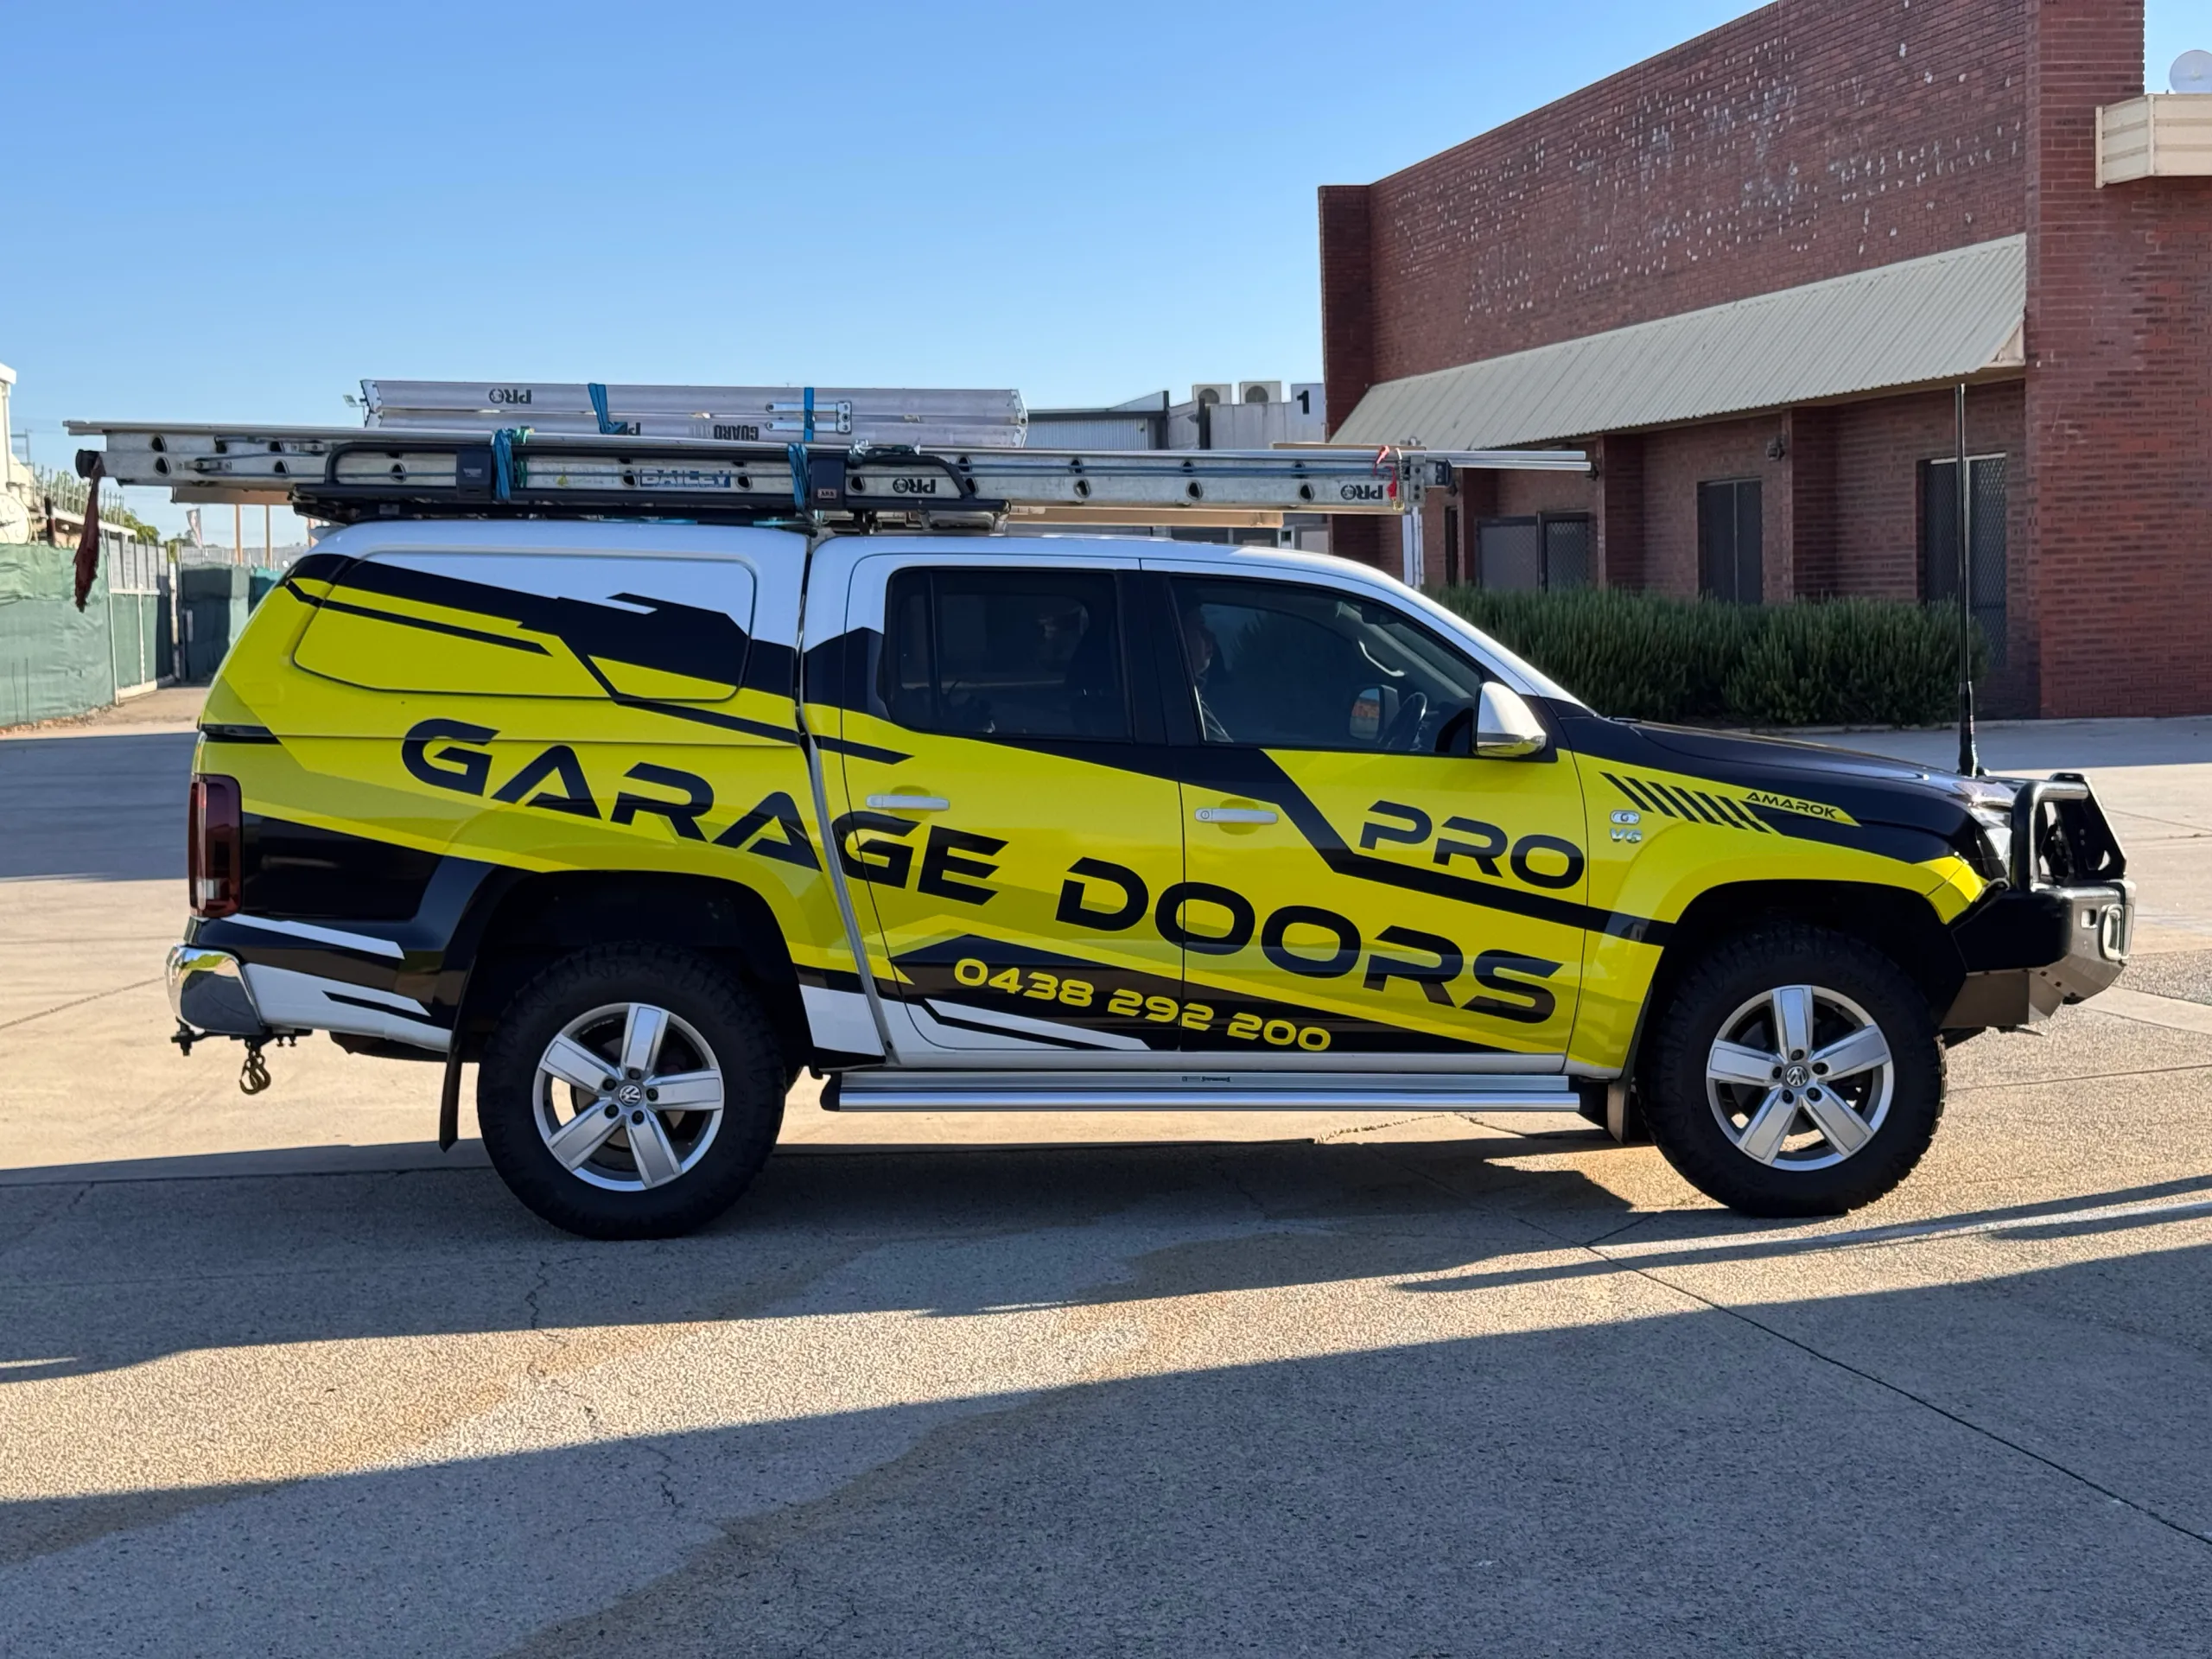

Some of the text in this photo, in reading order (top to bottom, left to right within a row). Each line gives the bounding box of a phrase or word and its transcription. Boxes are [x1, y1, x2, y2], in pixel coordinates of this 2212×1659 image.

[489, 389, 532, 405] PRO
[1297, 390, 1310, 415] 1
[713, 424, 760, 442] GUARD
[893, 478, 937, 494] PRO
[1340, 484, 1383, 500] PRO
[1745, 791, 1839, 820] AMAROK
[1359, 800, 1585, 888] PRO
[1610, 828, 1643, 843] V6
[402, 718, 1563, 1023] GARAGE DOORS
[953, 957, 1332, 1052] 0438 292 200
